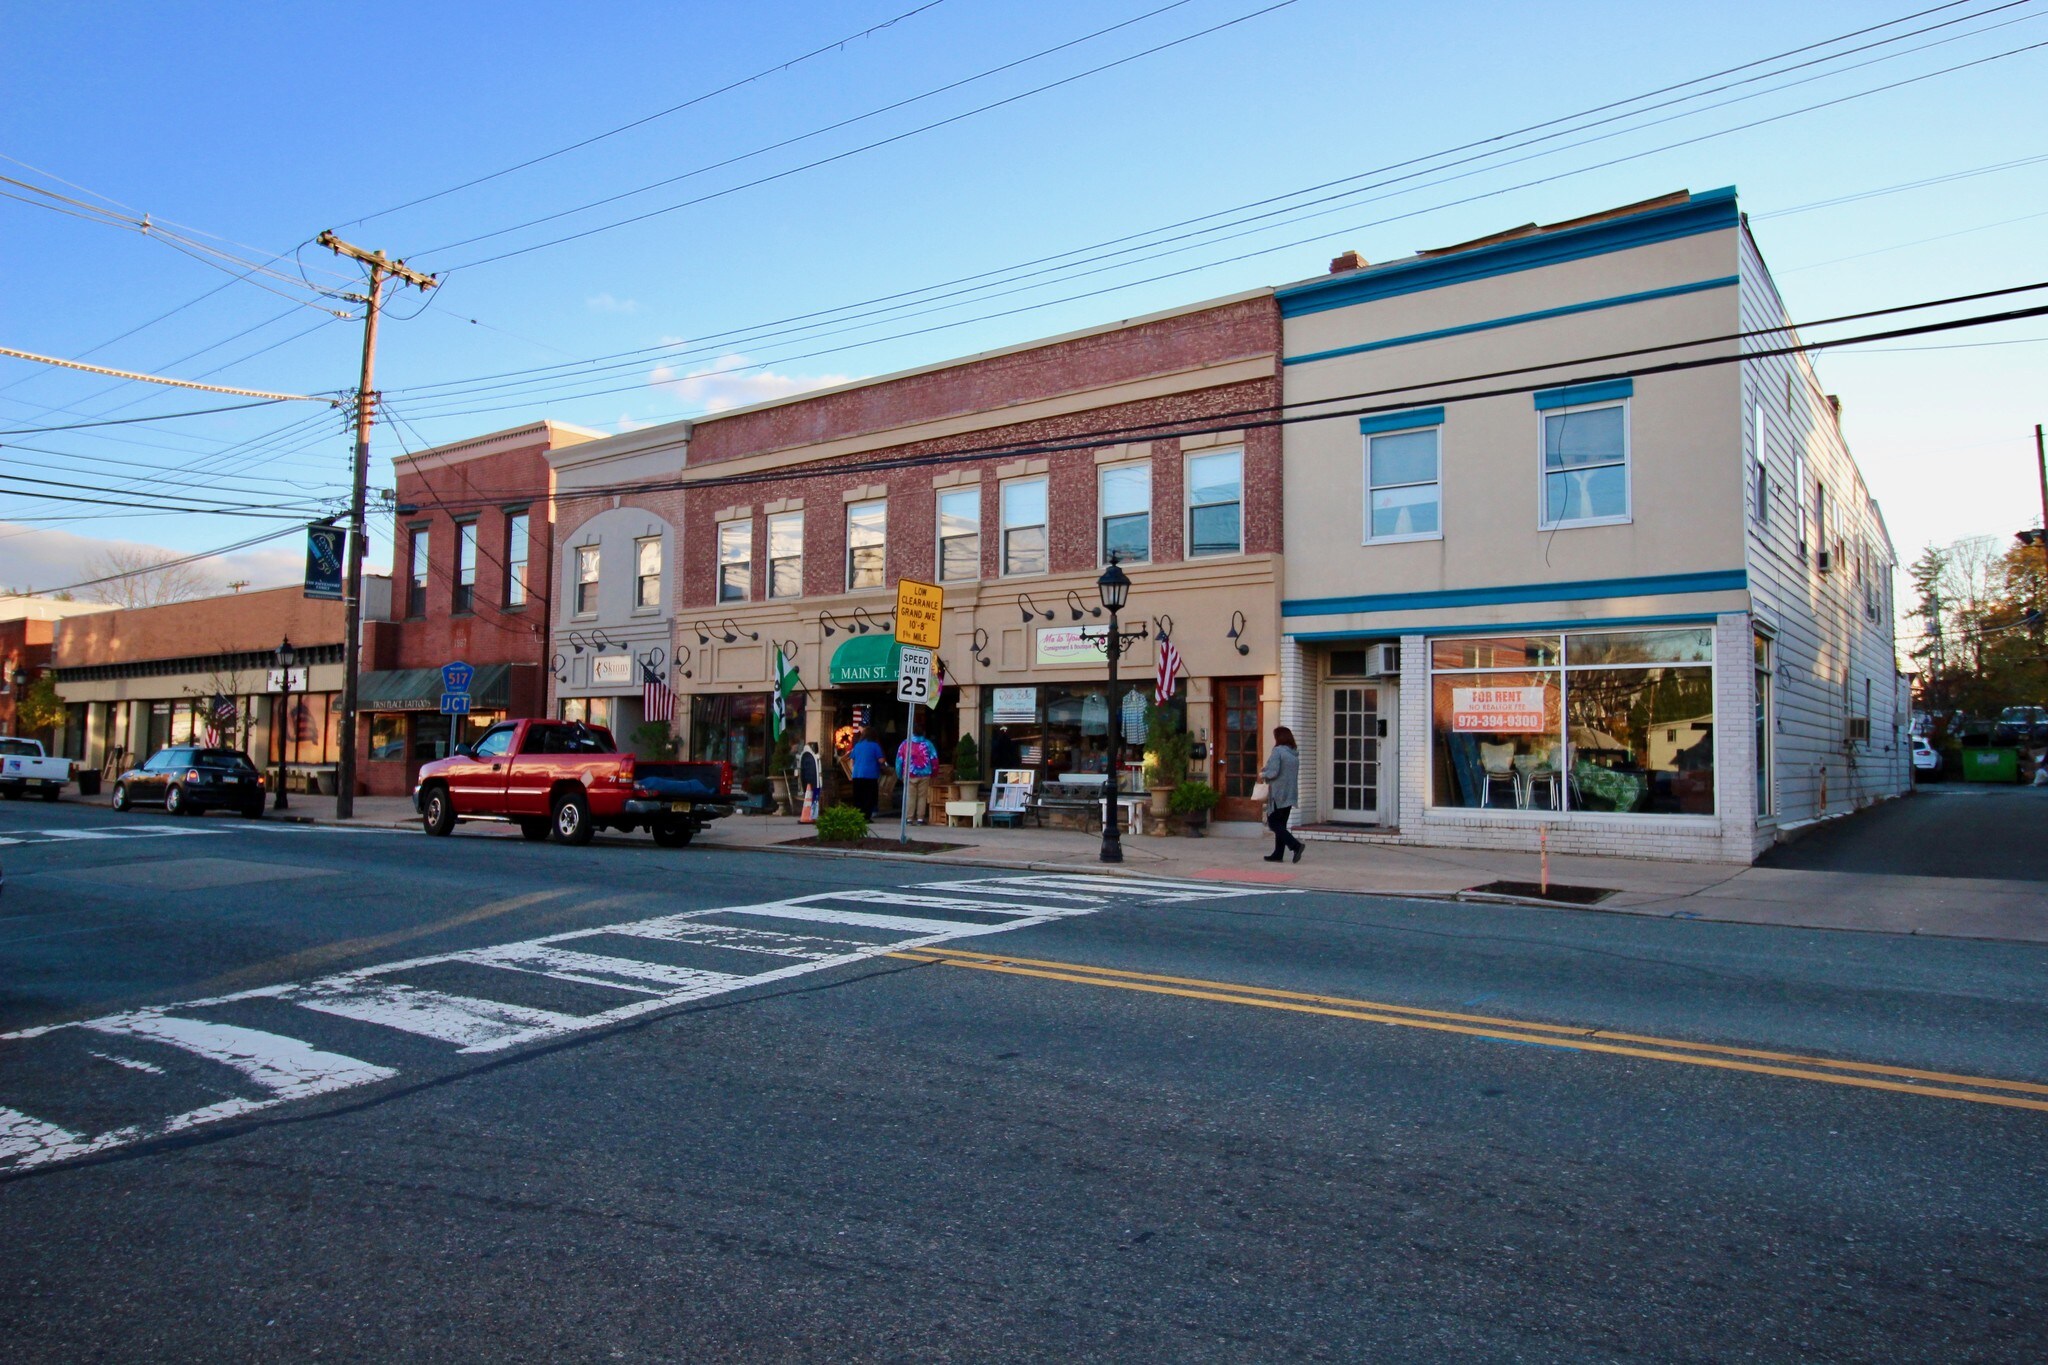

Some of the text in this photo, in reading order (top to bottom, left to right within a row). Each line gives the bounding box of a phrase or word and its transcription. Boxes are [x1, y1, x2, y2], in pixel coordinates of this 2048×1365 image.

[914, 587, 927, 596] LOW
[901, 595, 938, 610] CLEARANCE
[901, 607, 922, 618] GRAND
[913, 633, 927, 642] MILE
[903, 654, 929, 665] SPEED
[841, 667, 871, 679] MAIN
[873, 667, 887, 678] ST.
[905, 665, 926, 675] LIMIT
[448, 673, 469, 685] 517
[901, 676, 927, 697] 25
[1472, 691, 1522, 702] FOR RENT
[443, 697, 469, 711] JCT
